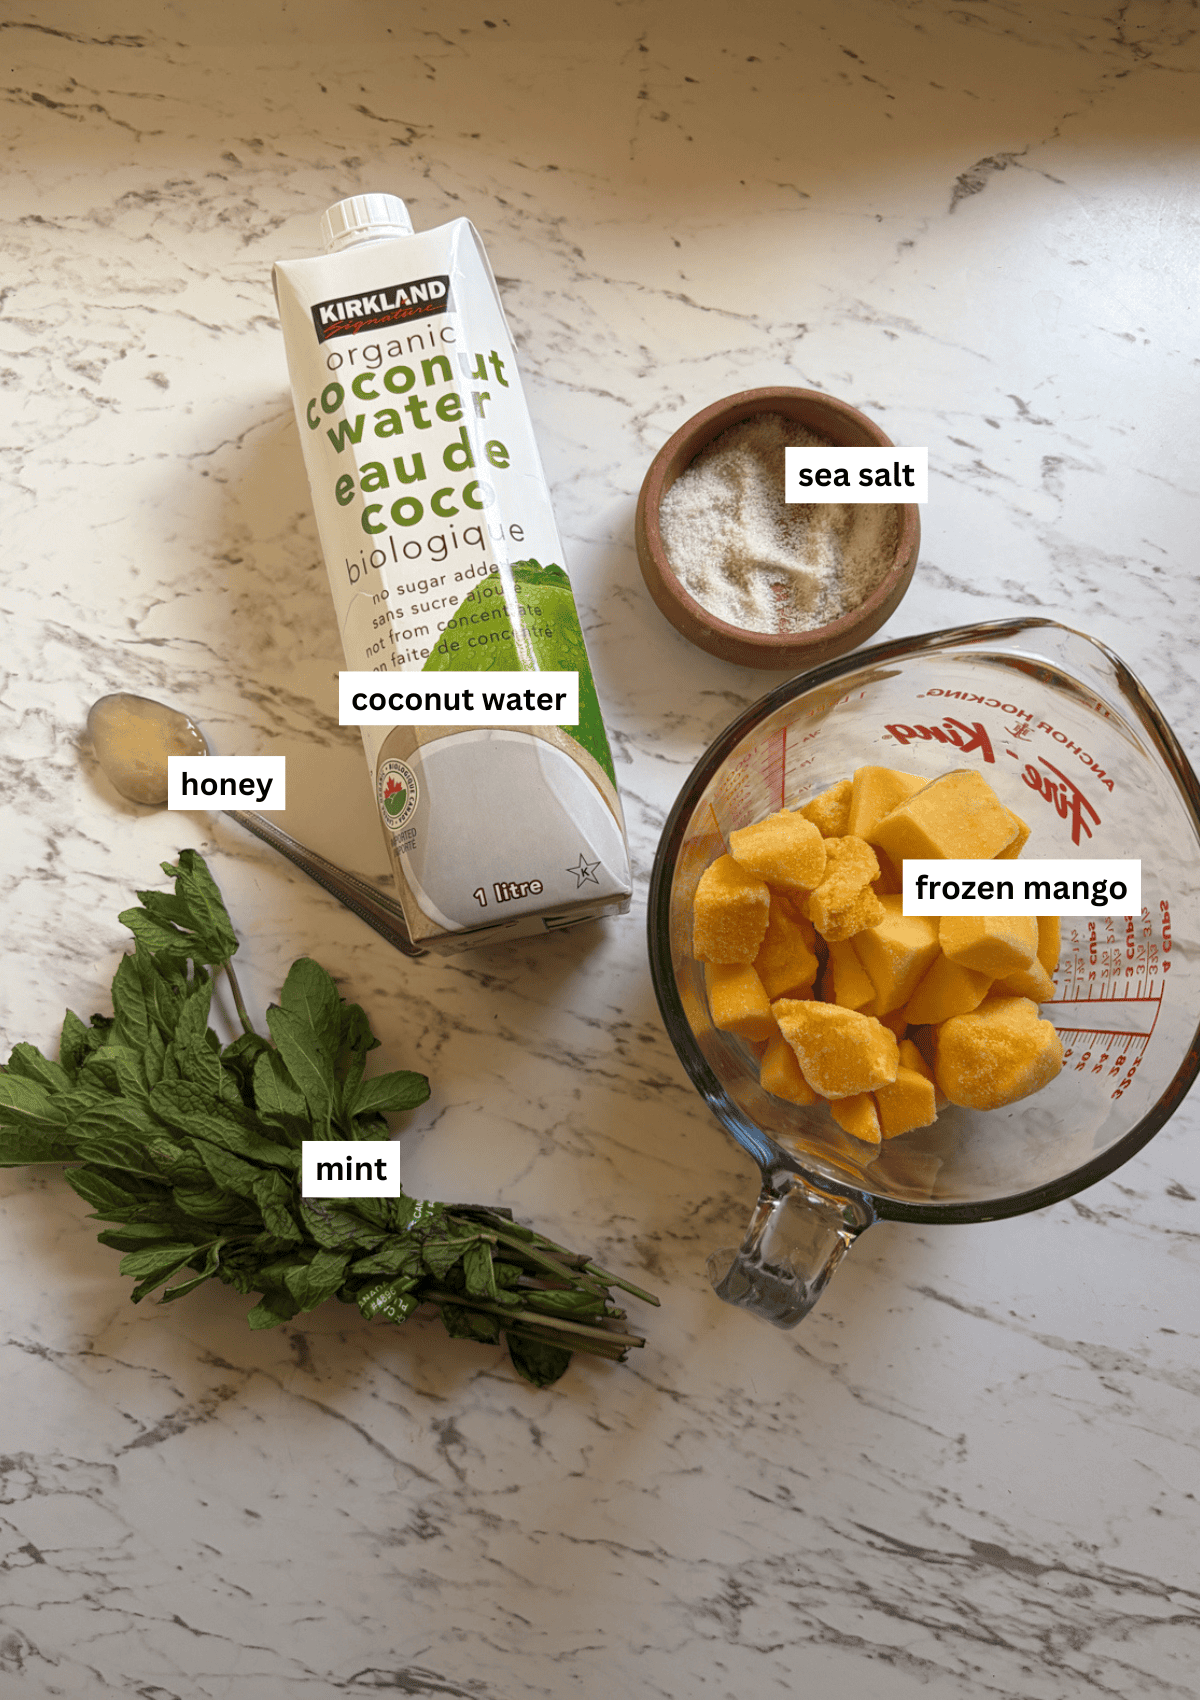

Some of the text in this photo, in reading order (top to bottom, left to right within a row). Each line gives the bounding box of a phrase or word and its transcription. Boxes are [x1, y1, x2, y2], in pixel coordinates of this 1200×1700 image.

[319, 281, 447, 325] KIRKLAND
[323, 303, 447, 339] Signature
[327, 324, 457, 371] organic
[307, 350, 509, 430] coconut
[326, 391, 491, 454] water
[335, 426, 510, 506] eau de
[361, 480, 496, 534] coco
[346, 523, 525, 585] biologique
[372, 589, 390, 605] no
[396, 575, 446, 595] sugar
[372, 608, 404, 629] sans
[411, 595, 459, 615] sucre
[366, 604, 543, 658] not from concentate
[391, 648, 430, 668] faite
[438, 639, 460, 655] de
[468, 624, 553, 648] concntré
[473, 879, 544, 907] 1 litre
[580, 866, 590, 878] K
